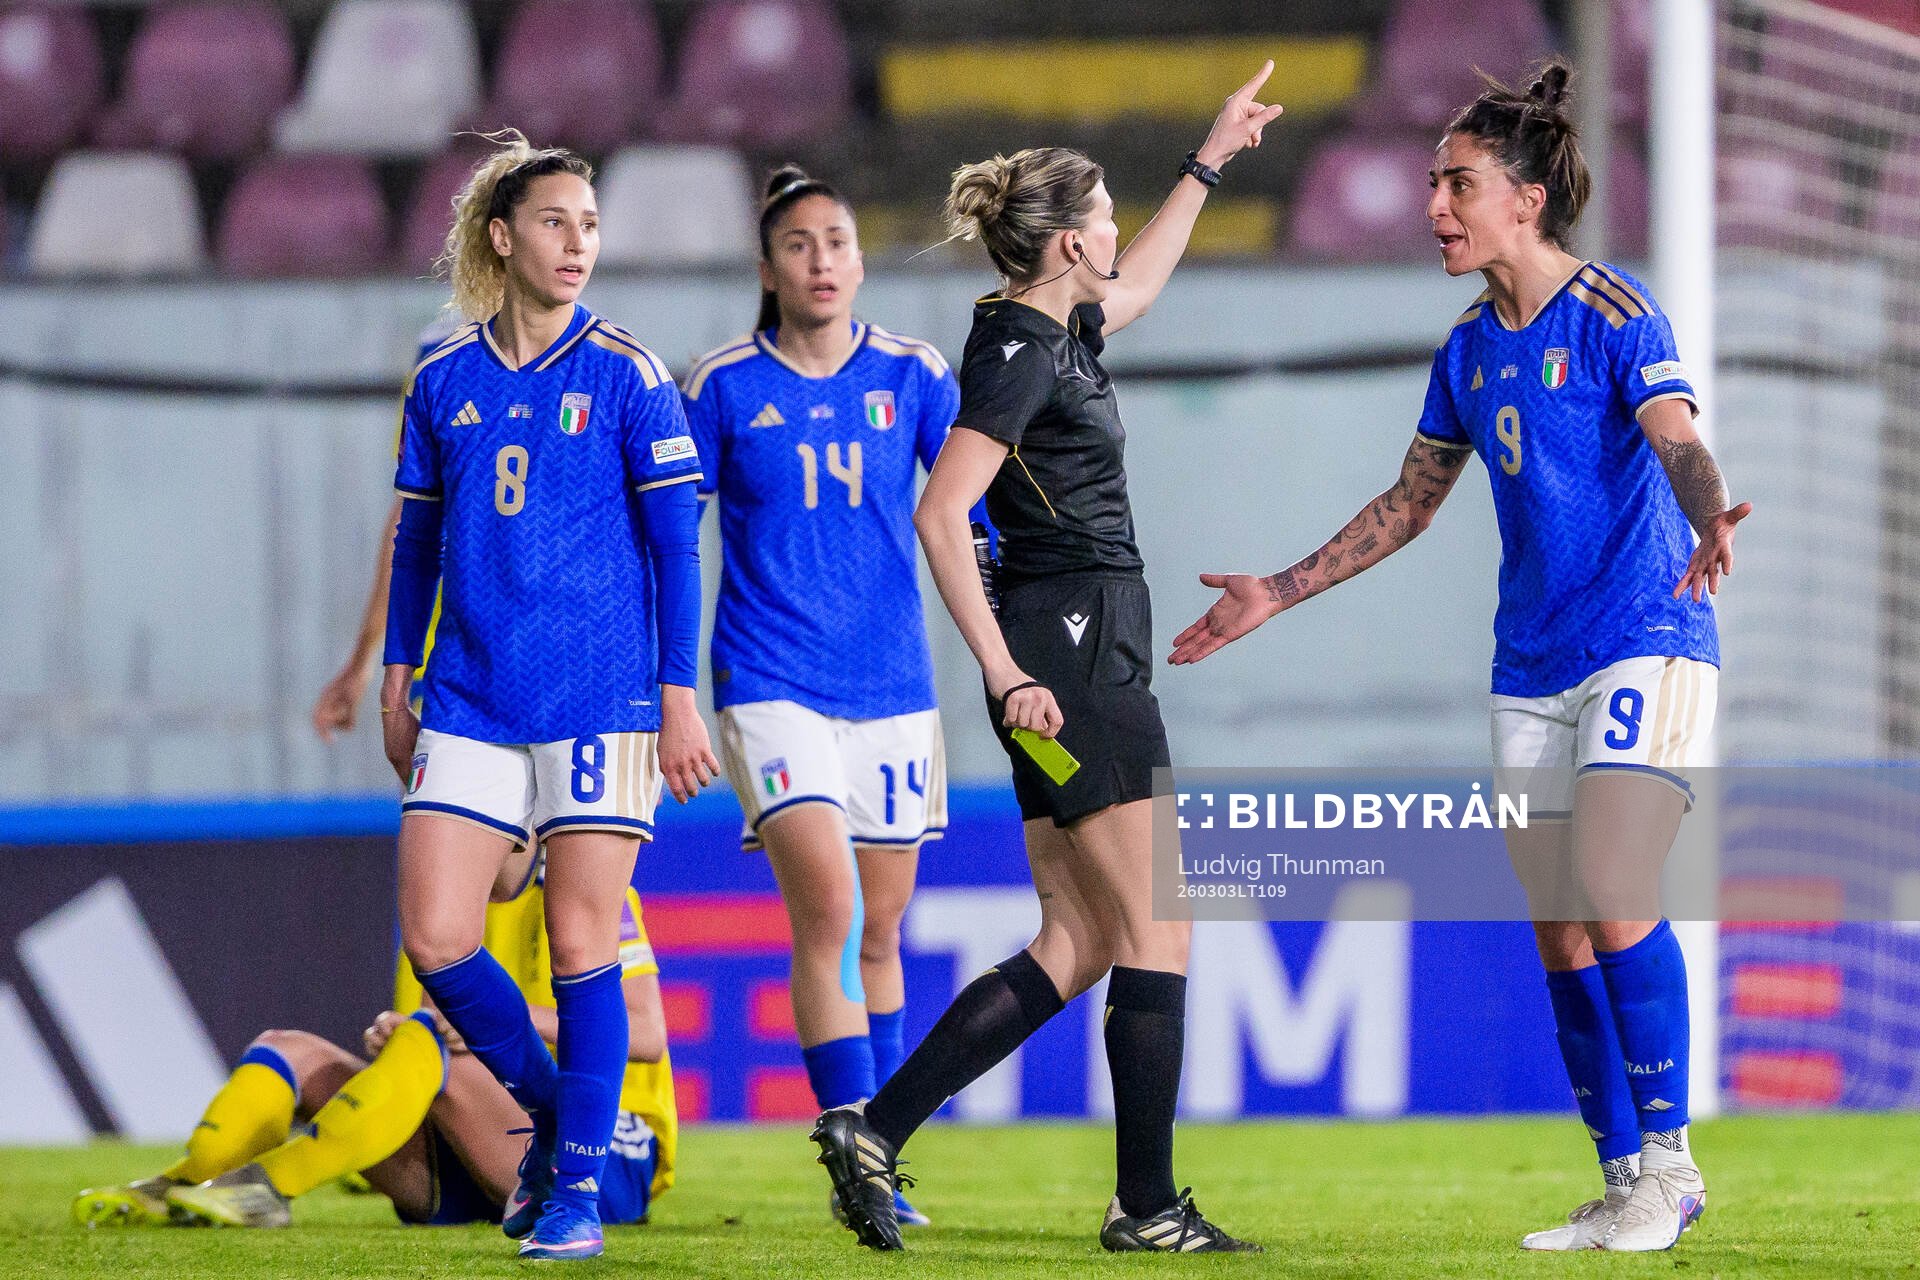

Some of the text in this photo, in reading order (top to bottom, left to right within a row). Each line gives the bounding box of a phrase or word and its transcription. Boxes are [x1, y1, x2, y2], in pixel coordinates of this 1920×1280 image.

[1496, 405, 1522, 475] 9
[494, 444, 529, 516] 8
[797, 441, 863, 509] 14
[1604, 687, 1644, 751] 9
[571, 735, 606, 803] 8
[565, 1140, 607, 1157] ITALIA
